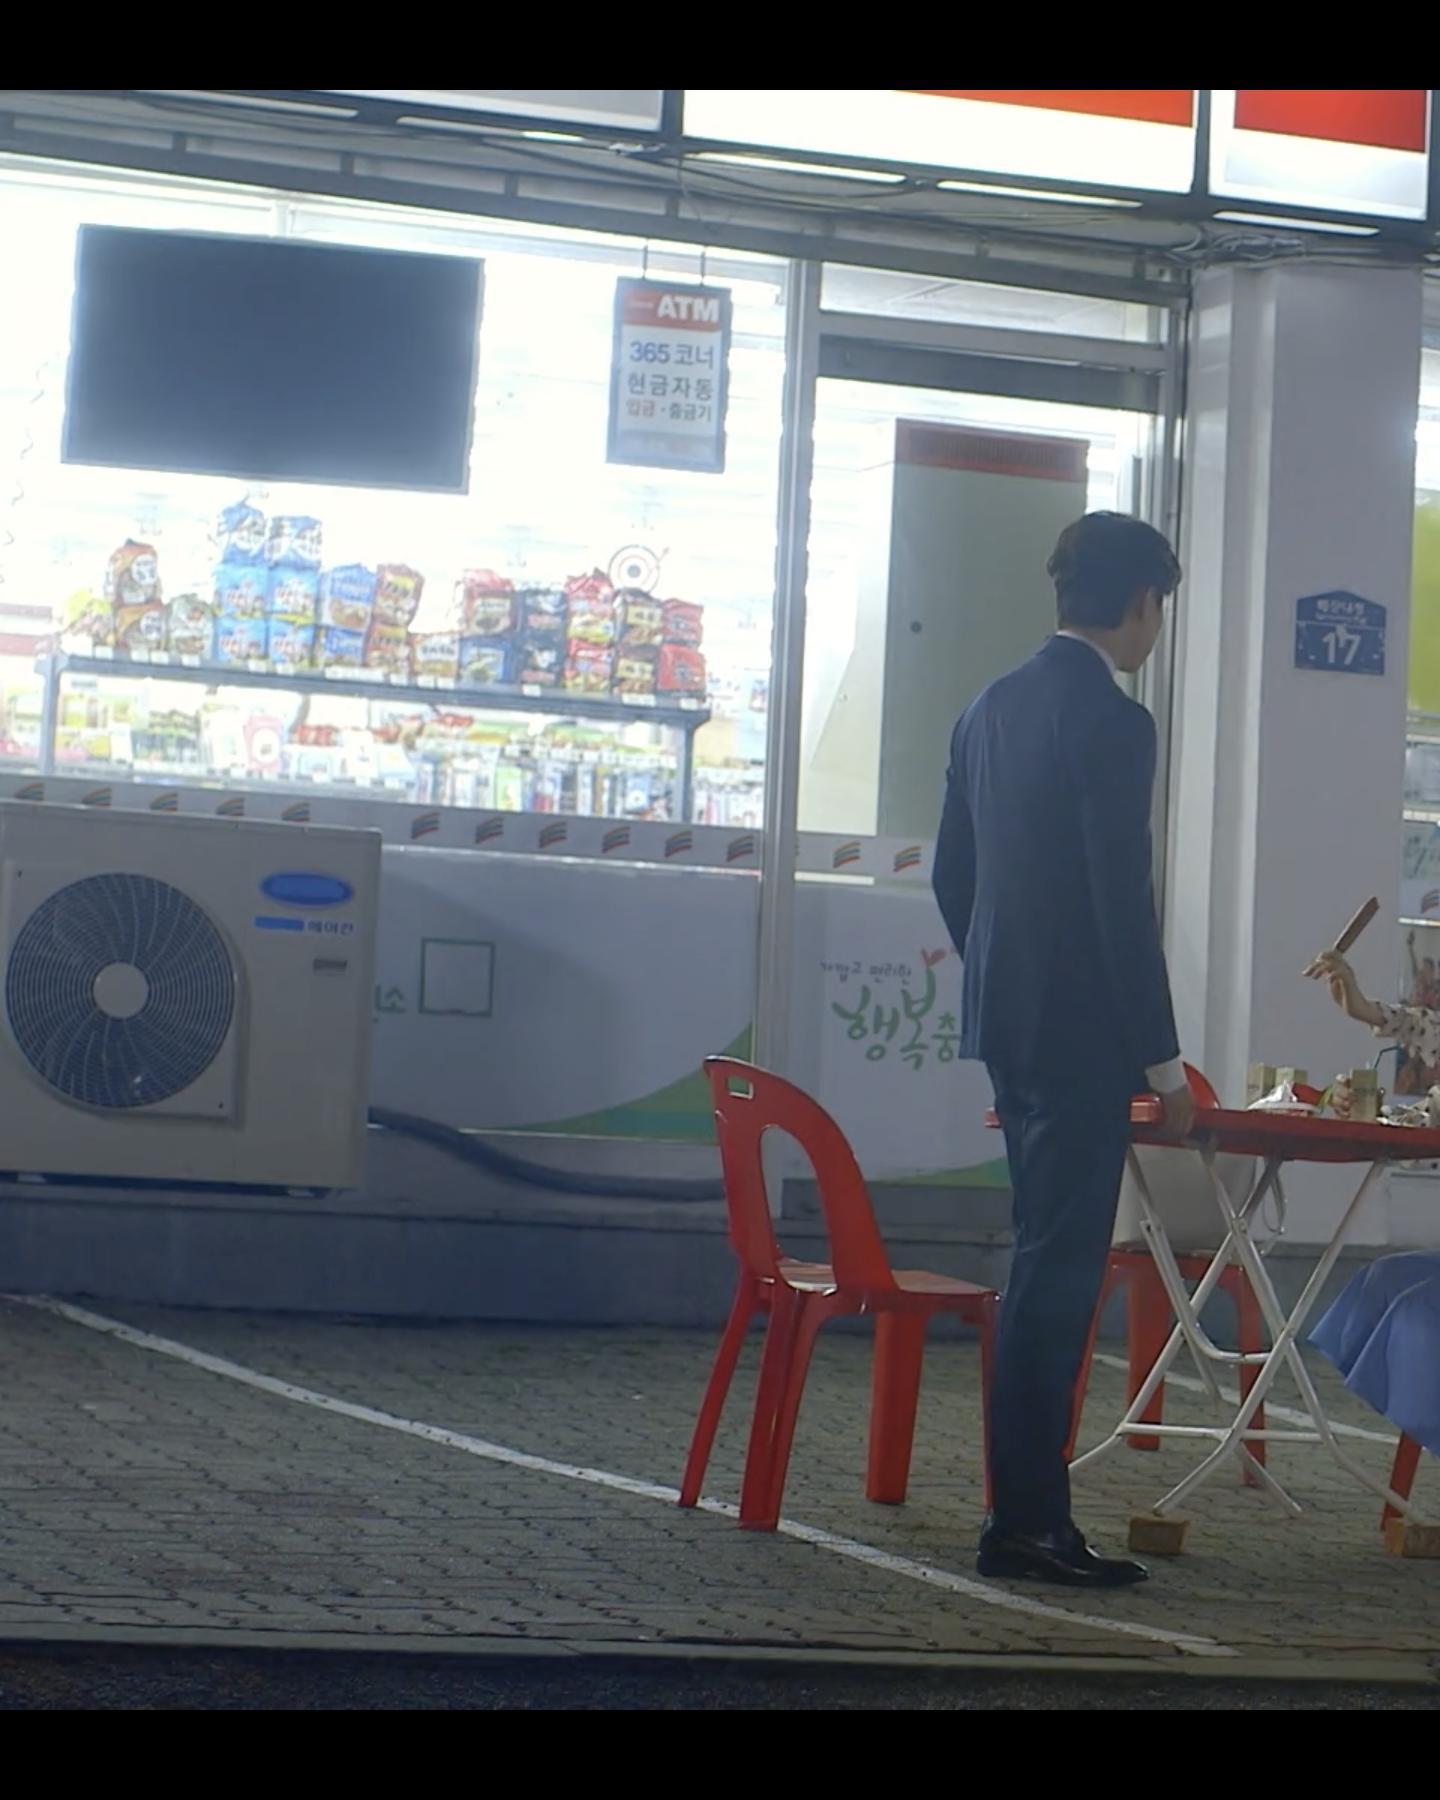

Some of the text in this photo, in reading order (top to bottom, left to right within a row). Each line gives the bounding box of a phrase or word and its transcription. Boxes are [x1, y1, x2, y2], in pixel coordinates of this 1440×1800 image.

[656, 294, 720, 323] ATM
[629, 341, 714, 370] 365 코너
[628, 372, 714, 401] 현금자동
[1322, 631, 1361, 666] 17
